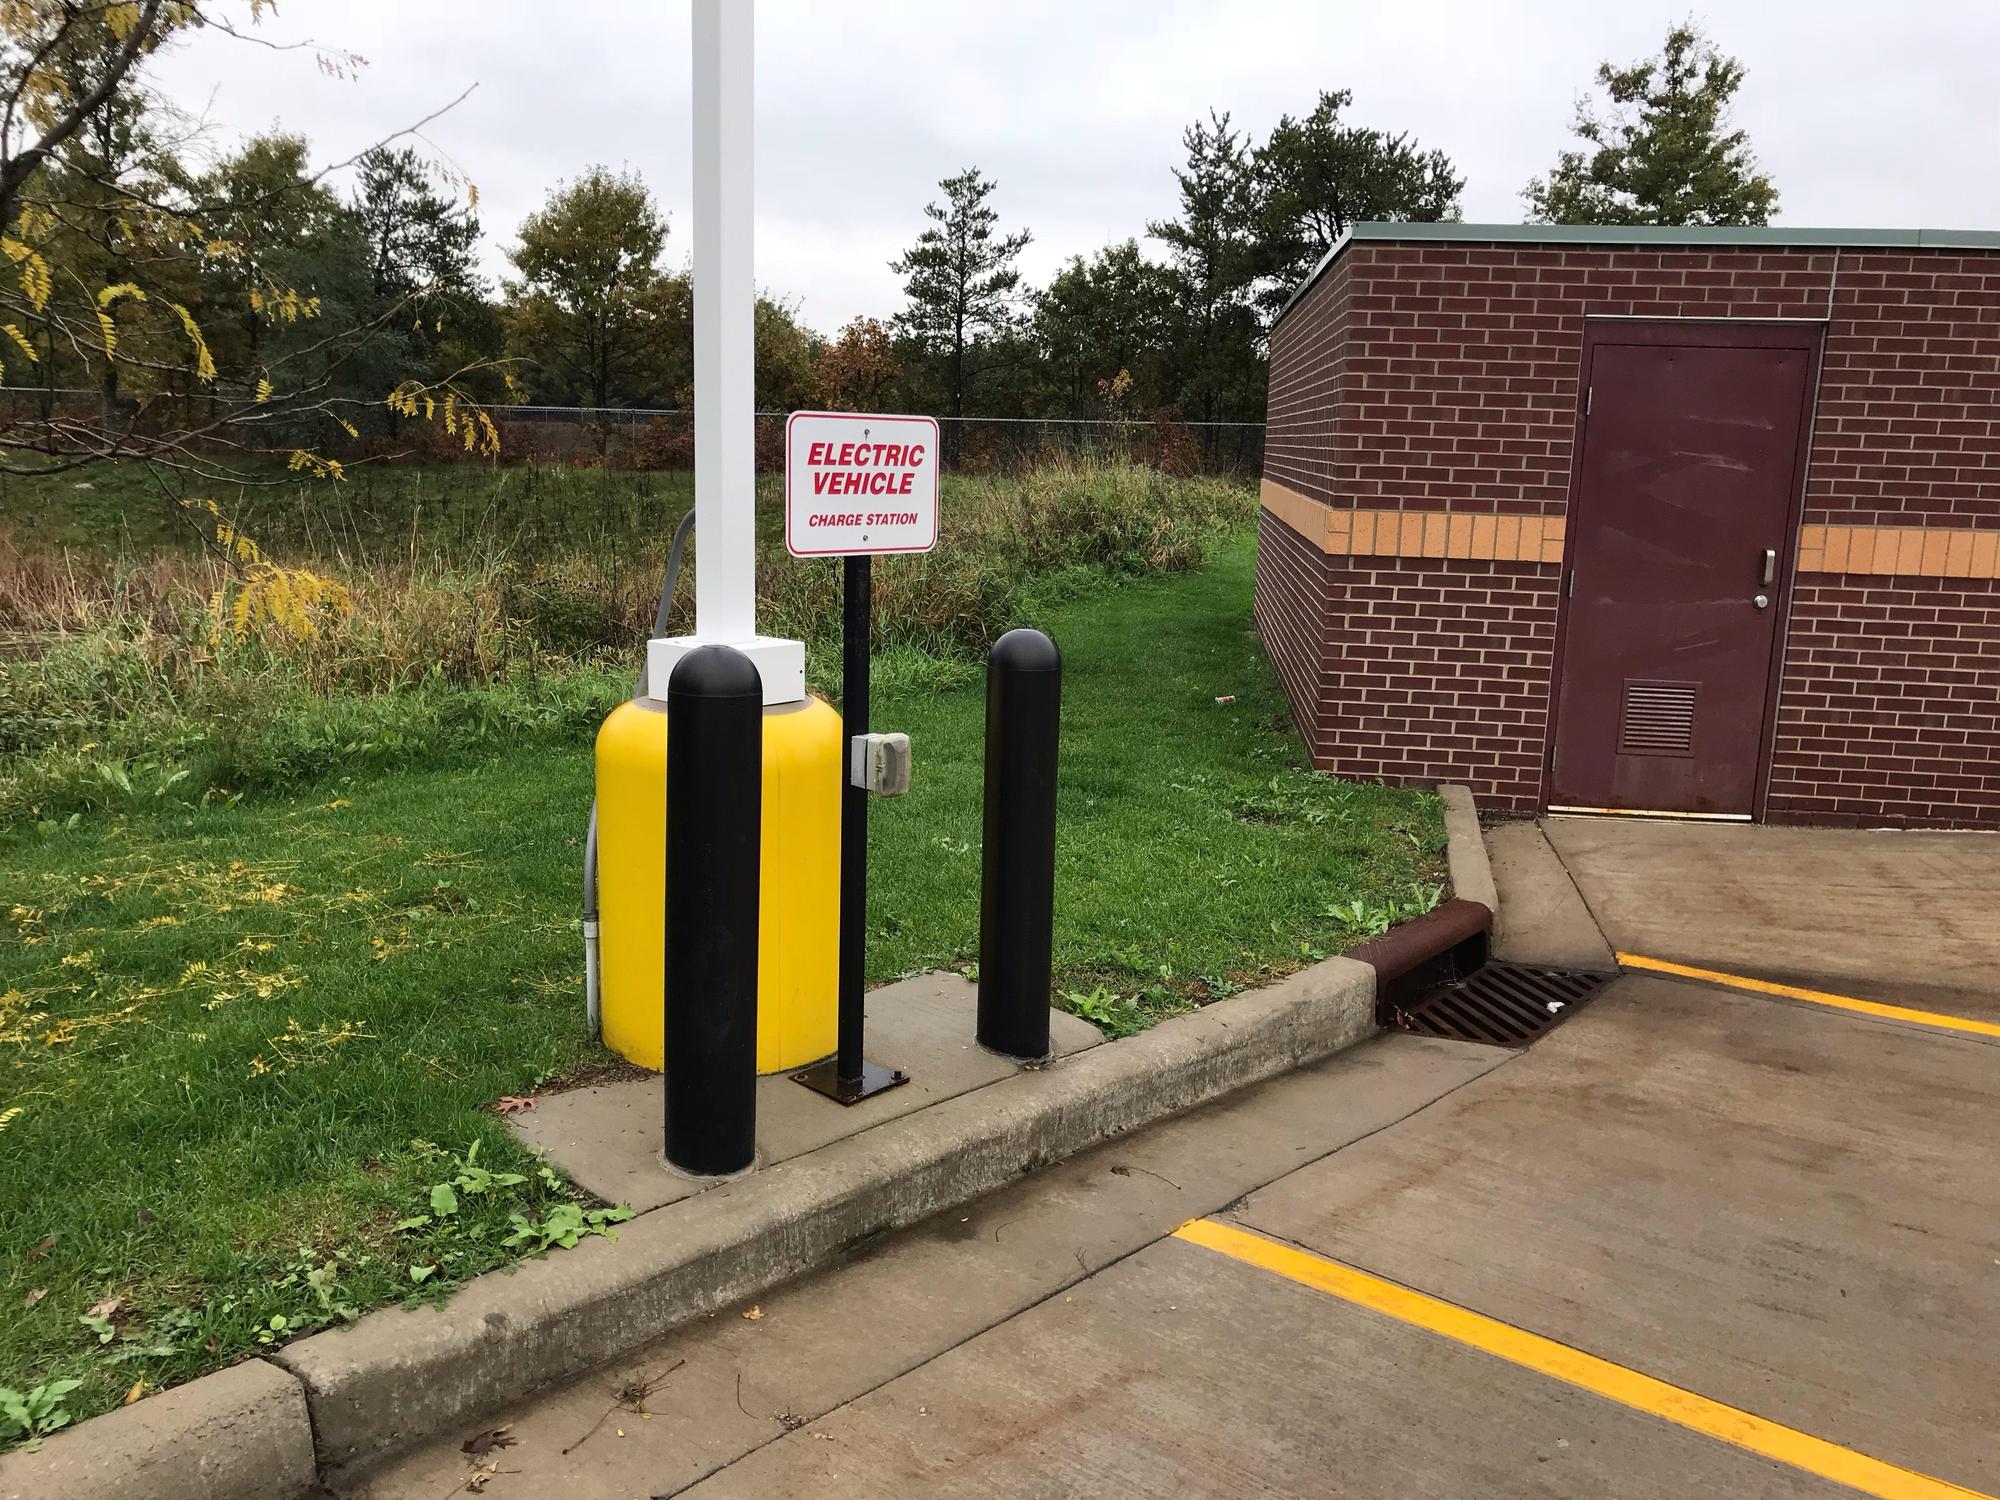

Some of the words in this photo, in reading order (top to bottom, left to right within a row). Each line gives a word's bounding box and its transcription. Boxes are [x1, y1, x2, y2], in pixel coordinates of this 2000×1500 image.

[807, 442, 925, 468] ELECTRIC
[813, 472, 915, 495] VEHICLE
[808, 514, 863, 527] CHARGE
[866, 513, 918, 526] STATION
